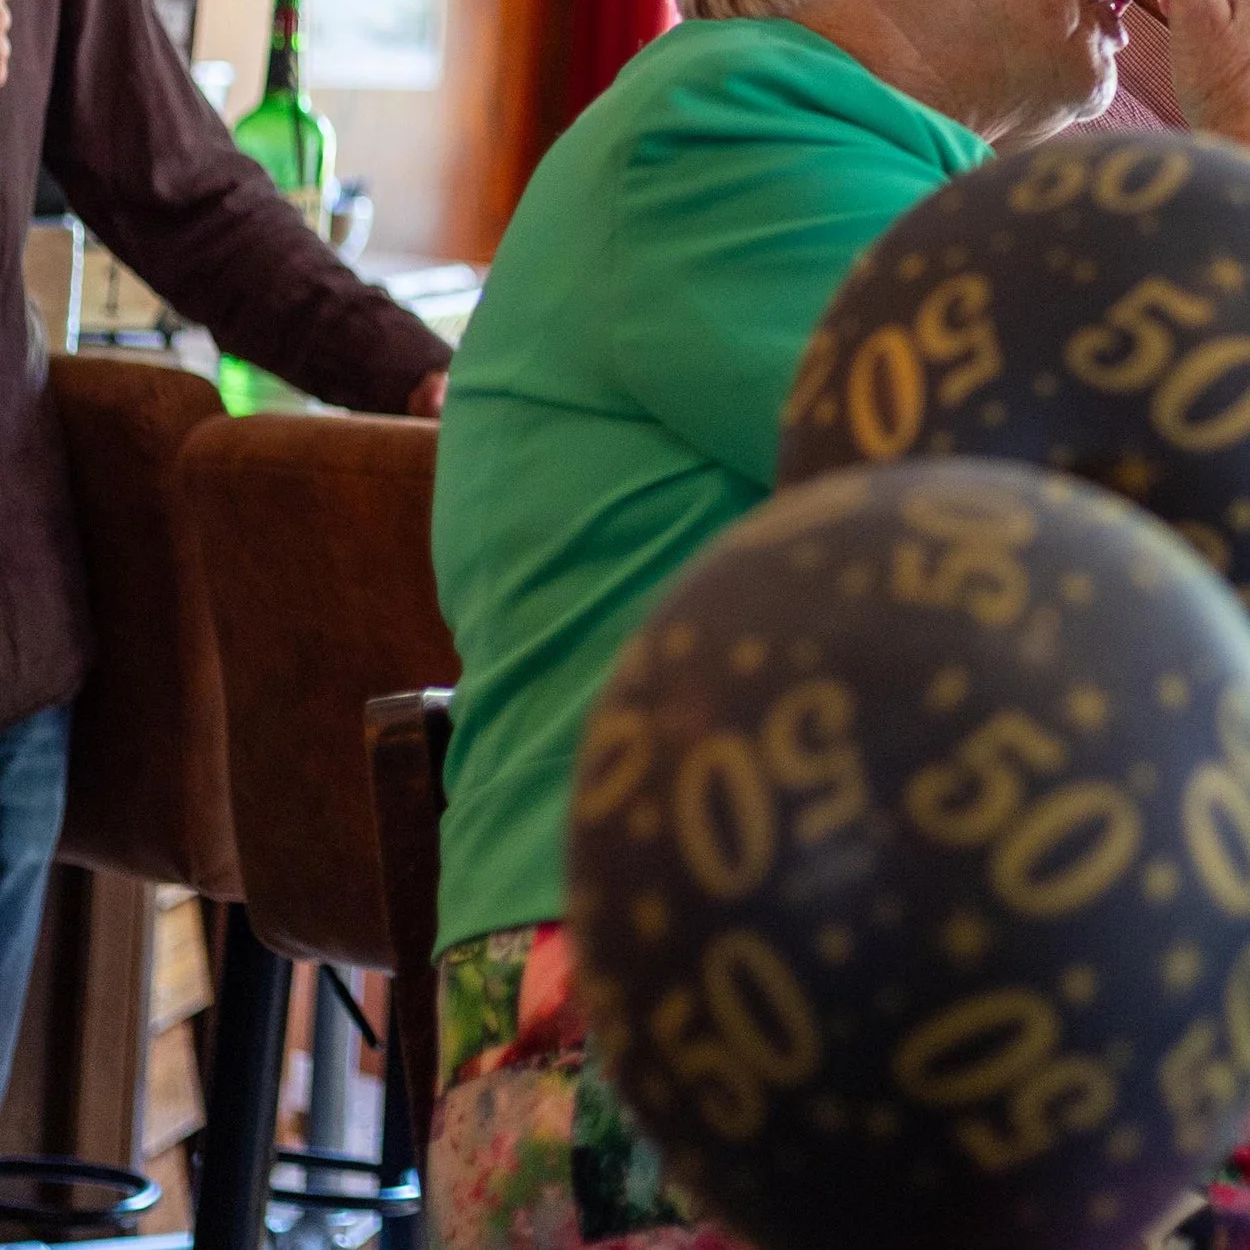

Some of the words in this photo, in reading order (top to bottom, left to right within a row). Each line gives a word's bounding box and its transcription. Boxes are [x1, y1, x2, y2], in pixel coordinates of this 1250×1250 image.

[847, 272, 1003, 456] 50
[674, 678, 868, 900] 50
[906, 710, 1143, 918] 50
[654, 930, 820, 1136] 50
[896, 988, 1114, 1170] 50
